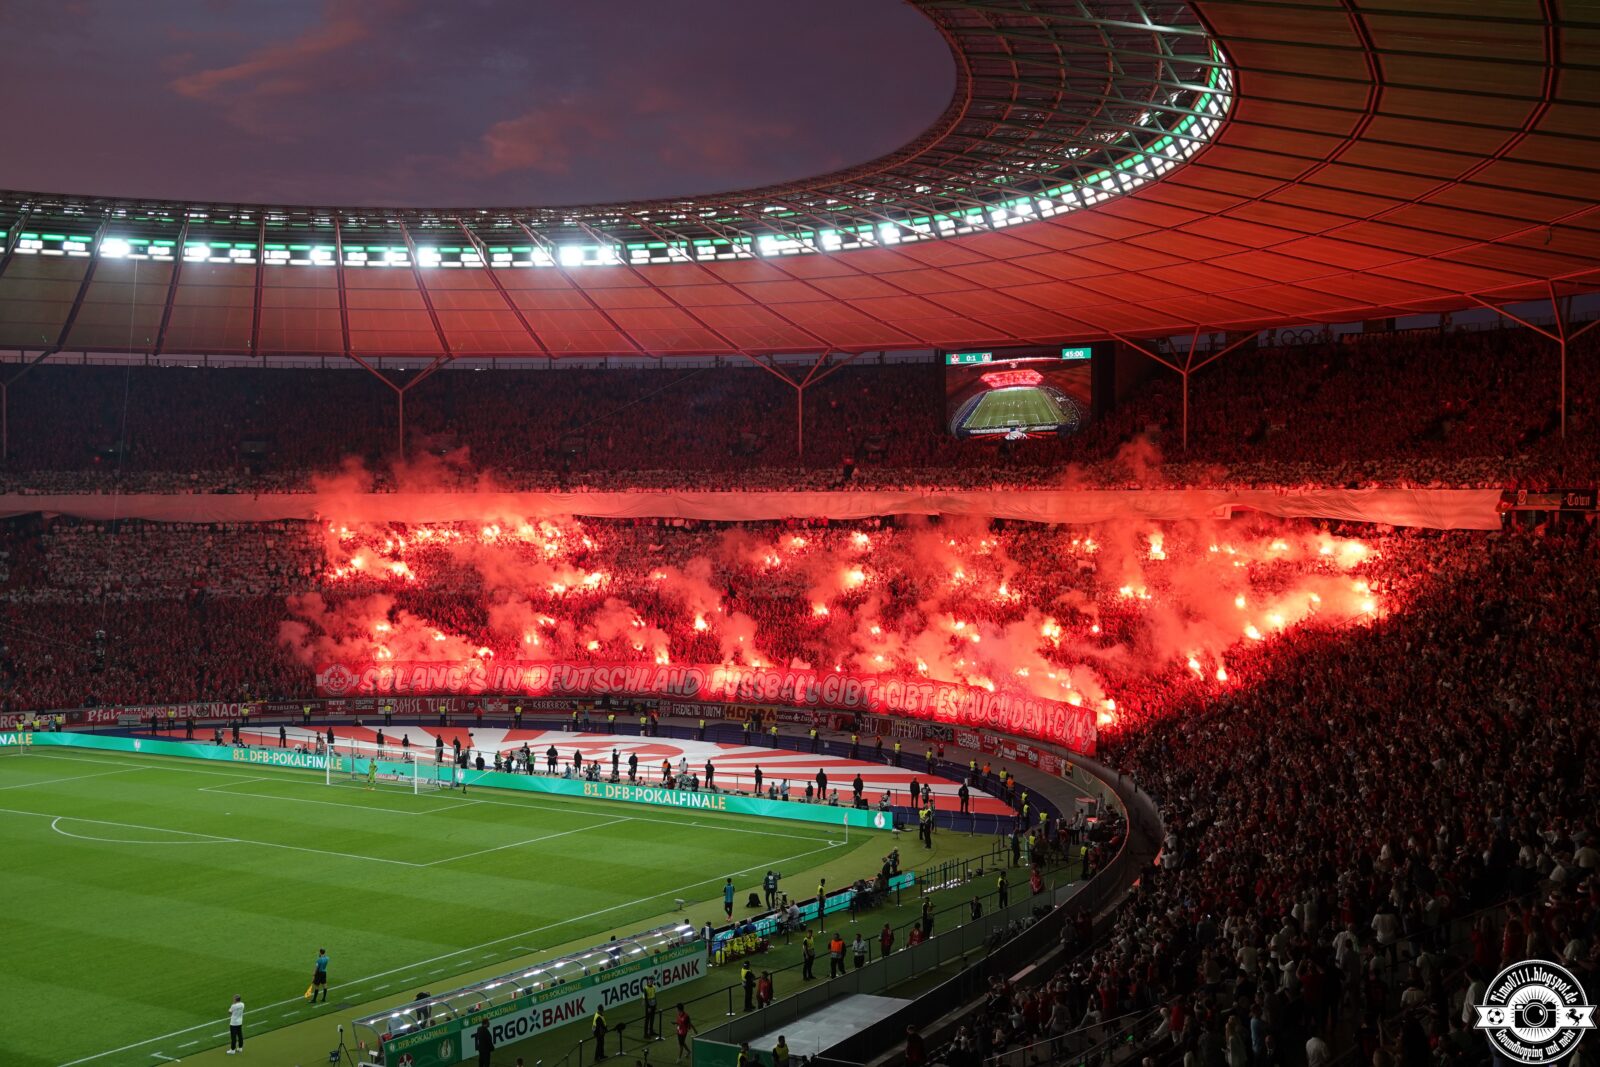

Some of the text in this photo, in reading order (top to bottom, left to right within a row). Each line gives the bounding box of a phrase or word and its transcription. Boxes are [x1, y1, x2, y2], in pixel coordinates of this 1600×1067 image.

[966, 354, 976, 362] 0:1
[1064, 350, 1084, 358] 45:00
[359, 665, 489, 691] SOLANG'S
[493, 666, 523, 691] IN
[526, 665, 703, 695] DEUTSCHLAND
[709, 667, 819, 702] FUSSBALL
[885, 680, 932, 714] GIBT
[937, 686, 958, 719] ES
[963, 691, 1008, 726] AUCH
[1011, 698, 1044, 734] DEN
[249, 750, 342, 770] DFB-POKALFINALE
[584, 783, 726, 811] 81. DFB-POKALFINALE
